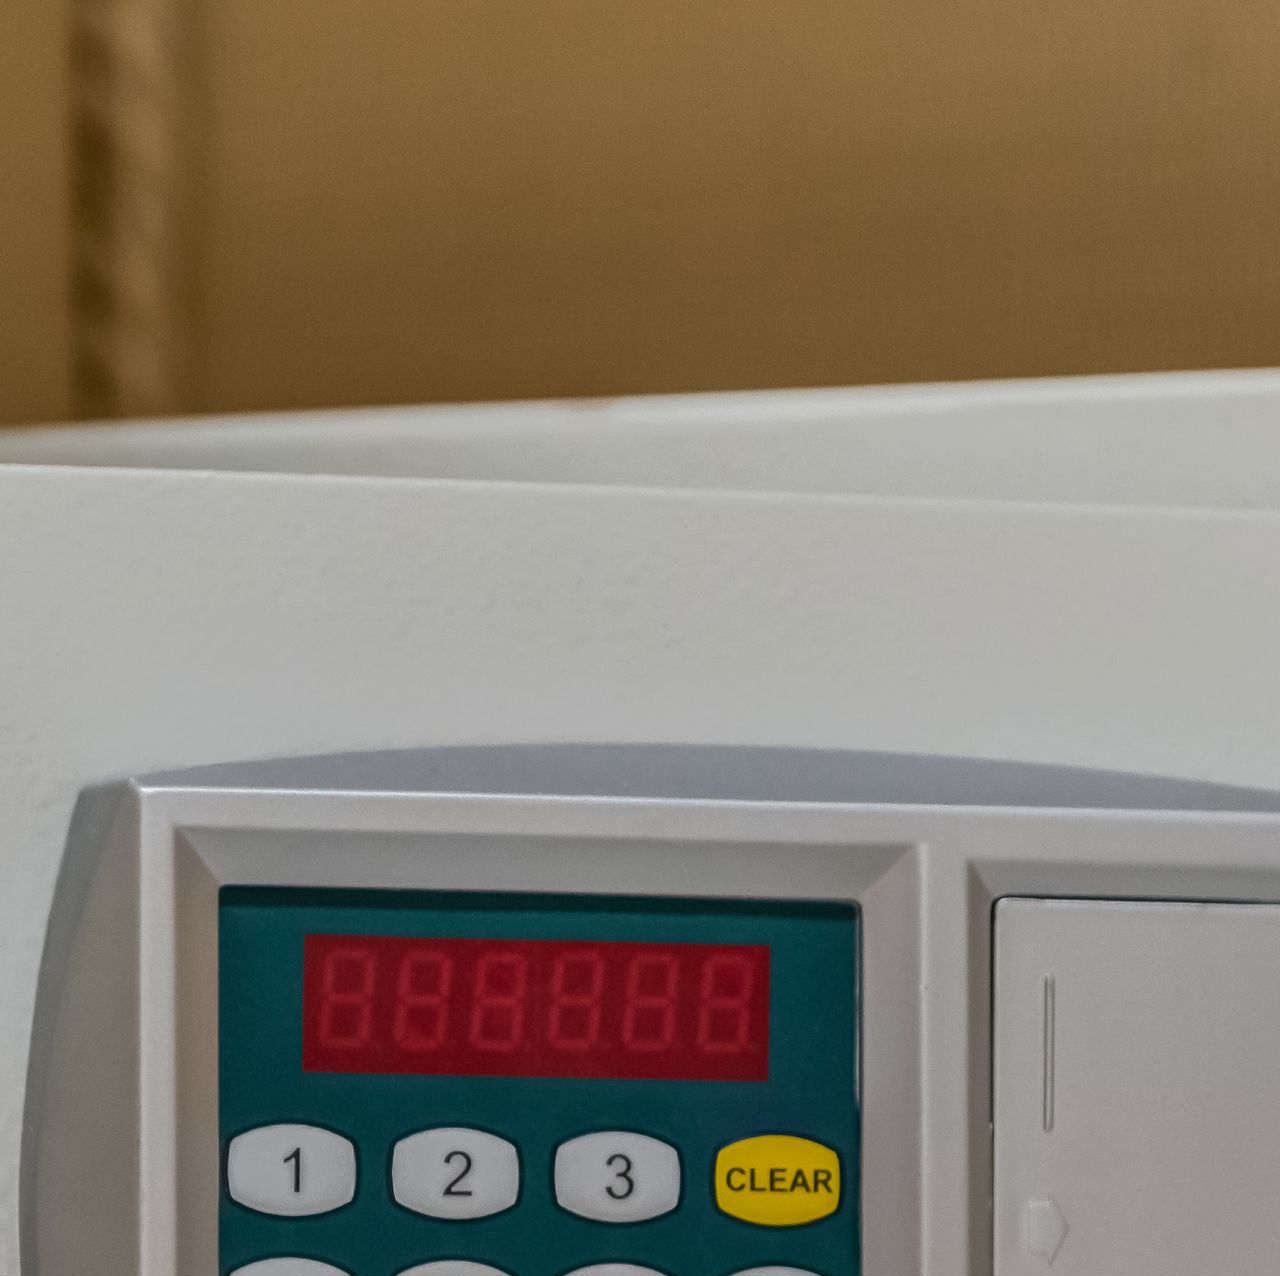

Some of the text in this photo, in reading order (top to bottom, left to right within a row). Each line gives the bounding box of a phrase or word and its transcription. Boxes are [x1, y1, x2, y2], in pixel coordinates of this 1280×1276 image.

[283, 1147, 301, 1193] 1
[442, 1150, 473, 1197] 2
[605, 1153, 635, 1200] 3
[725, 1167, 833, 1194] CLEAR
